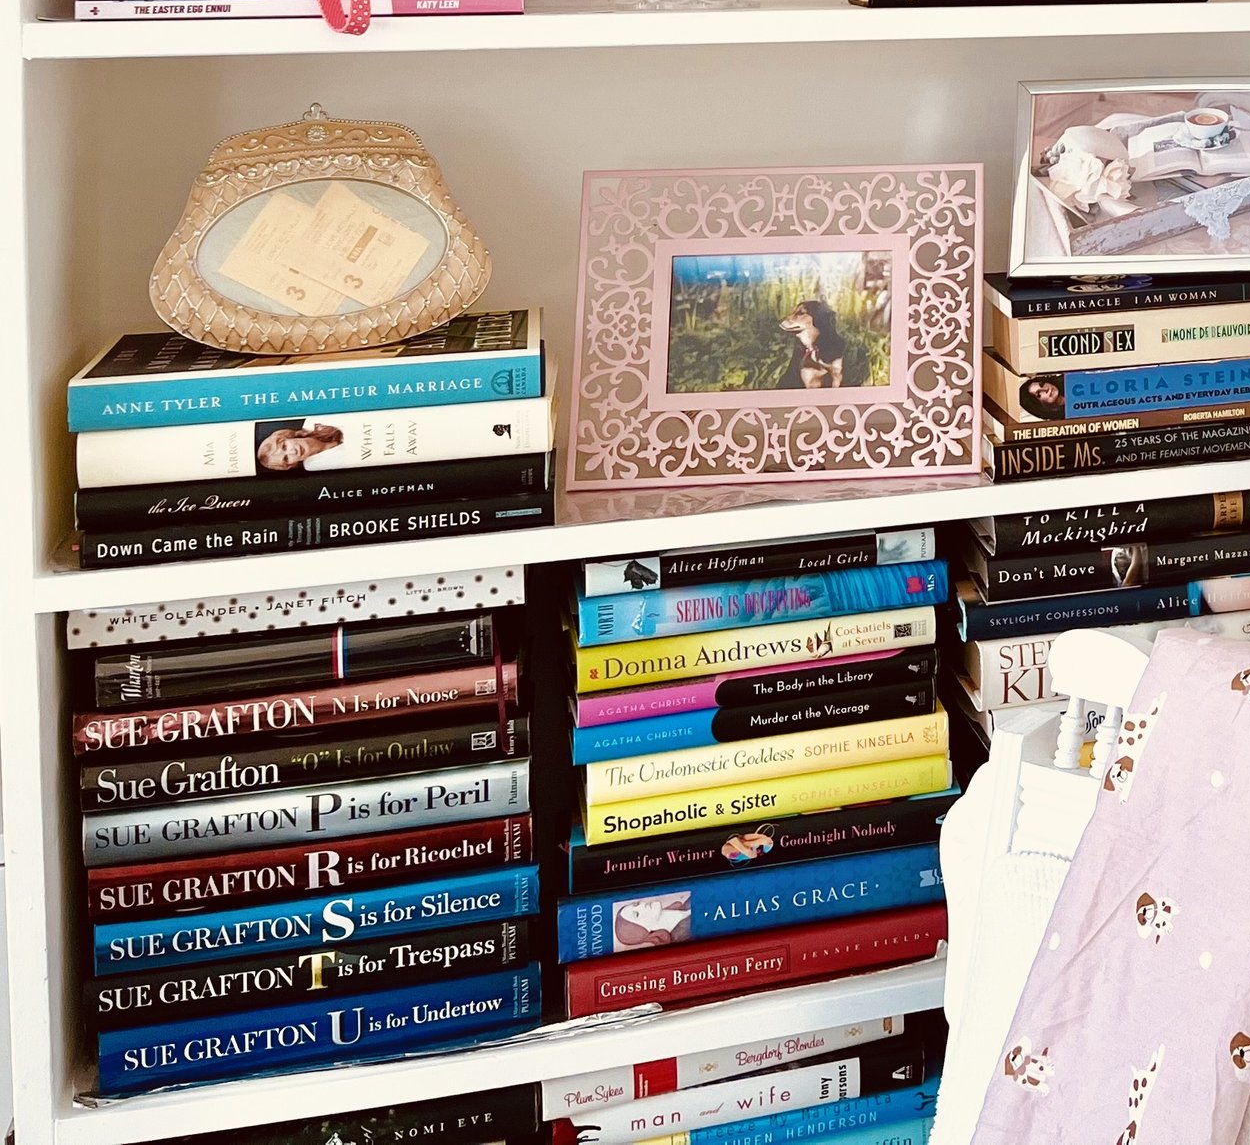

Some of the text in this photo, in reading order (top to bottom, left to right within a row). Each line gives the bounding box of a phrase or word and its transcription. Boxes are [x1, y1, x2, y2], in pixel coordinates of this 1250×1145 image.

[134, 6, 149, 14] THE
[152, 6, 184, 14] EASTER
[187, 5, 203, 13] EGG
[1040, 328, 1133, 357] SECOND SEX
[102, 378, 482, 415] ANNE TYLER THE AMATEUR MARRIAGE
[1072, 378, 1168, 397] GLORIA
[1074, 397, 1136, 410] OUTRAGEOUS
[1139, 395, 1162, 404] ACTS
[1165, 393, 1184, 401] AND
[1186, 388, 1230, 399] EVERYDAY
[1014, 419, 1139, 440] THE LIBERATION OF WOMEN
[1115, 438, 1128, 448] 25
[1131, 435, 1161, 446] YEARS
[1165, 434, 1177, 442] OF
[1182, 430, 1199, 440] THE
[330, 519, 399, 538] BROOKE
[408, 511, 480, 530] SHIELDS
[1024, 504, 1145, 526] TO KILL A
[97, 542, 143, 558] Down
[152, 539, 197, 553] Came
[206, 534, 233, 548] the
[242, 530, 278, 544] Rain
[1022, 518, 1148, 546] Mockingbird
[799, 551, 869, 569] Local Girls
[999, 564, 1095, 583] Don't Move
[110, 594, 366, 625] WHITE OLEANDER JANET FITCH
[990, 606, 1119, 626] SKYLIGHT CONFESSIONS
[604, 641, 802, 679] Donna Andrews
[753, 672, 873, 694] The Body in the Library
[599, 696, 696, 717] AGATHA CHRISTIE
[751, 704, 869, 726] Murder at the Vicarage
[85, 696, 316, 752] SUE GRAFTON
[97, 756, 280, 803] Sue Grafton
[605, 747, 795, 786] The Undomestic Goddess
[306, 779, 491, 833] P is for Peril
[604, 793, 777, 833] Shopaholic & Sister
[96, 807, 298, 849] SUE GRAFTON
[780, 821, 896, 848] Goodnight Nobody
[304, 850, 344, 890] R
[348, 857, 363, 874] is
[371, 853, 400, 870] for
[405, 838, 493, 866] Ricochet
[604, 848, 715, 874] Jennifer Weiner
[322, 899, 355, 943] S
[360, 906, 377, 927] is
[383, 901, 415, 923] for
[421, 893, 500, 917] Silence
[110, 914, 311, 961] SUE GRAFTON
[299, 951, 335, 991] T
[338, 959, 353, 977] is
[359, 956, 385, 974] for
[390, 939, 495, 969] Trespass
[601, 956, 783, 997] Crossing Brooklyn Ferry
[328, 998, 502, 1045] U is for Undertow
[124, 1022, 317, 1071] SUE GRAFTON
[631, 1086, 791, 1131] man and wife
[394, 1113, 493, 1140] NOMI EVE
